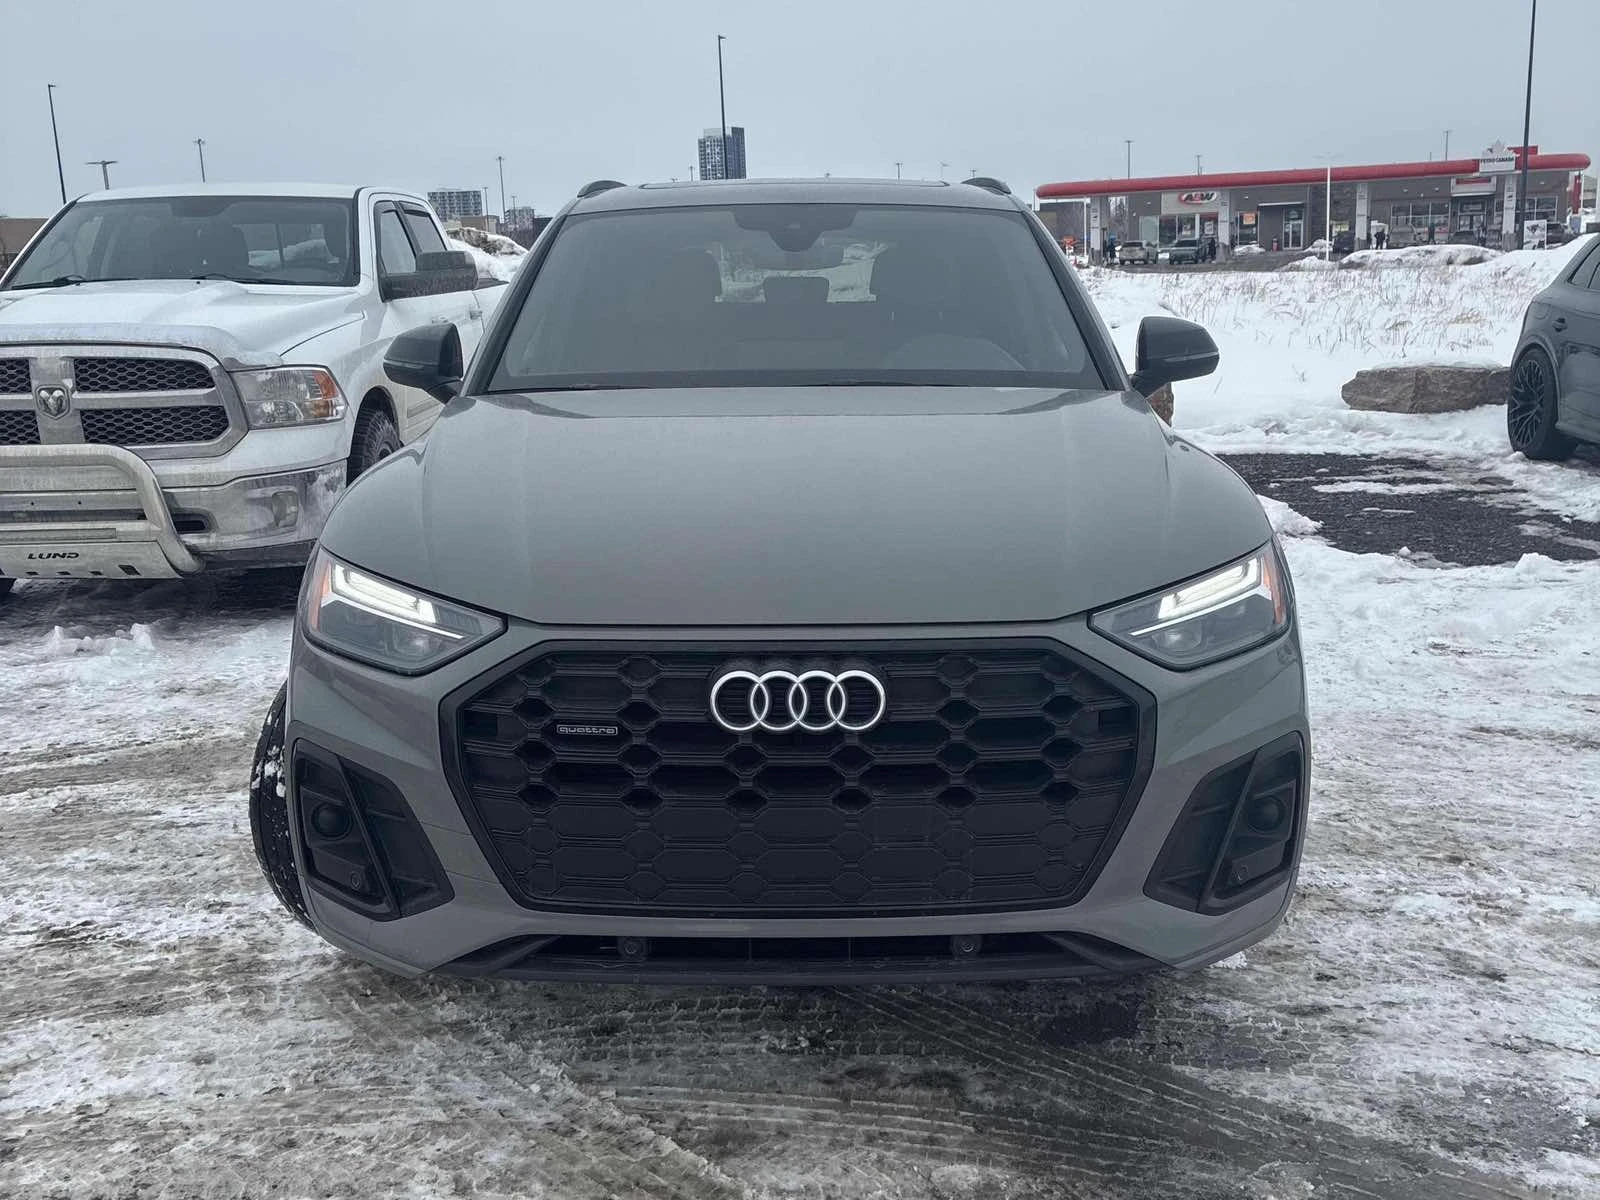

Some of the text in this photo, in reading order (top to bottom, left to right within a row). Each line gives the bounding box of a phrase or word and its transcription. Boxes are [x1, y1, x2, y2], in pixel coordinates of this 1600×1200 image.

[1183, 192, 1215, 202] A&W
[27, 552, 80, 560] LUND
[559, 726, 615, 734] quattro
